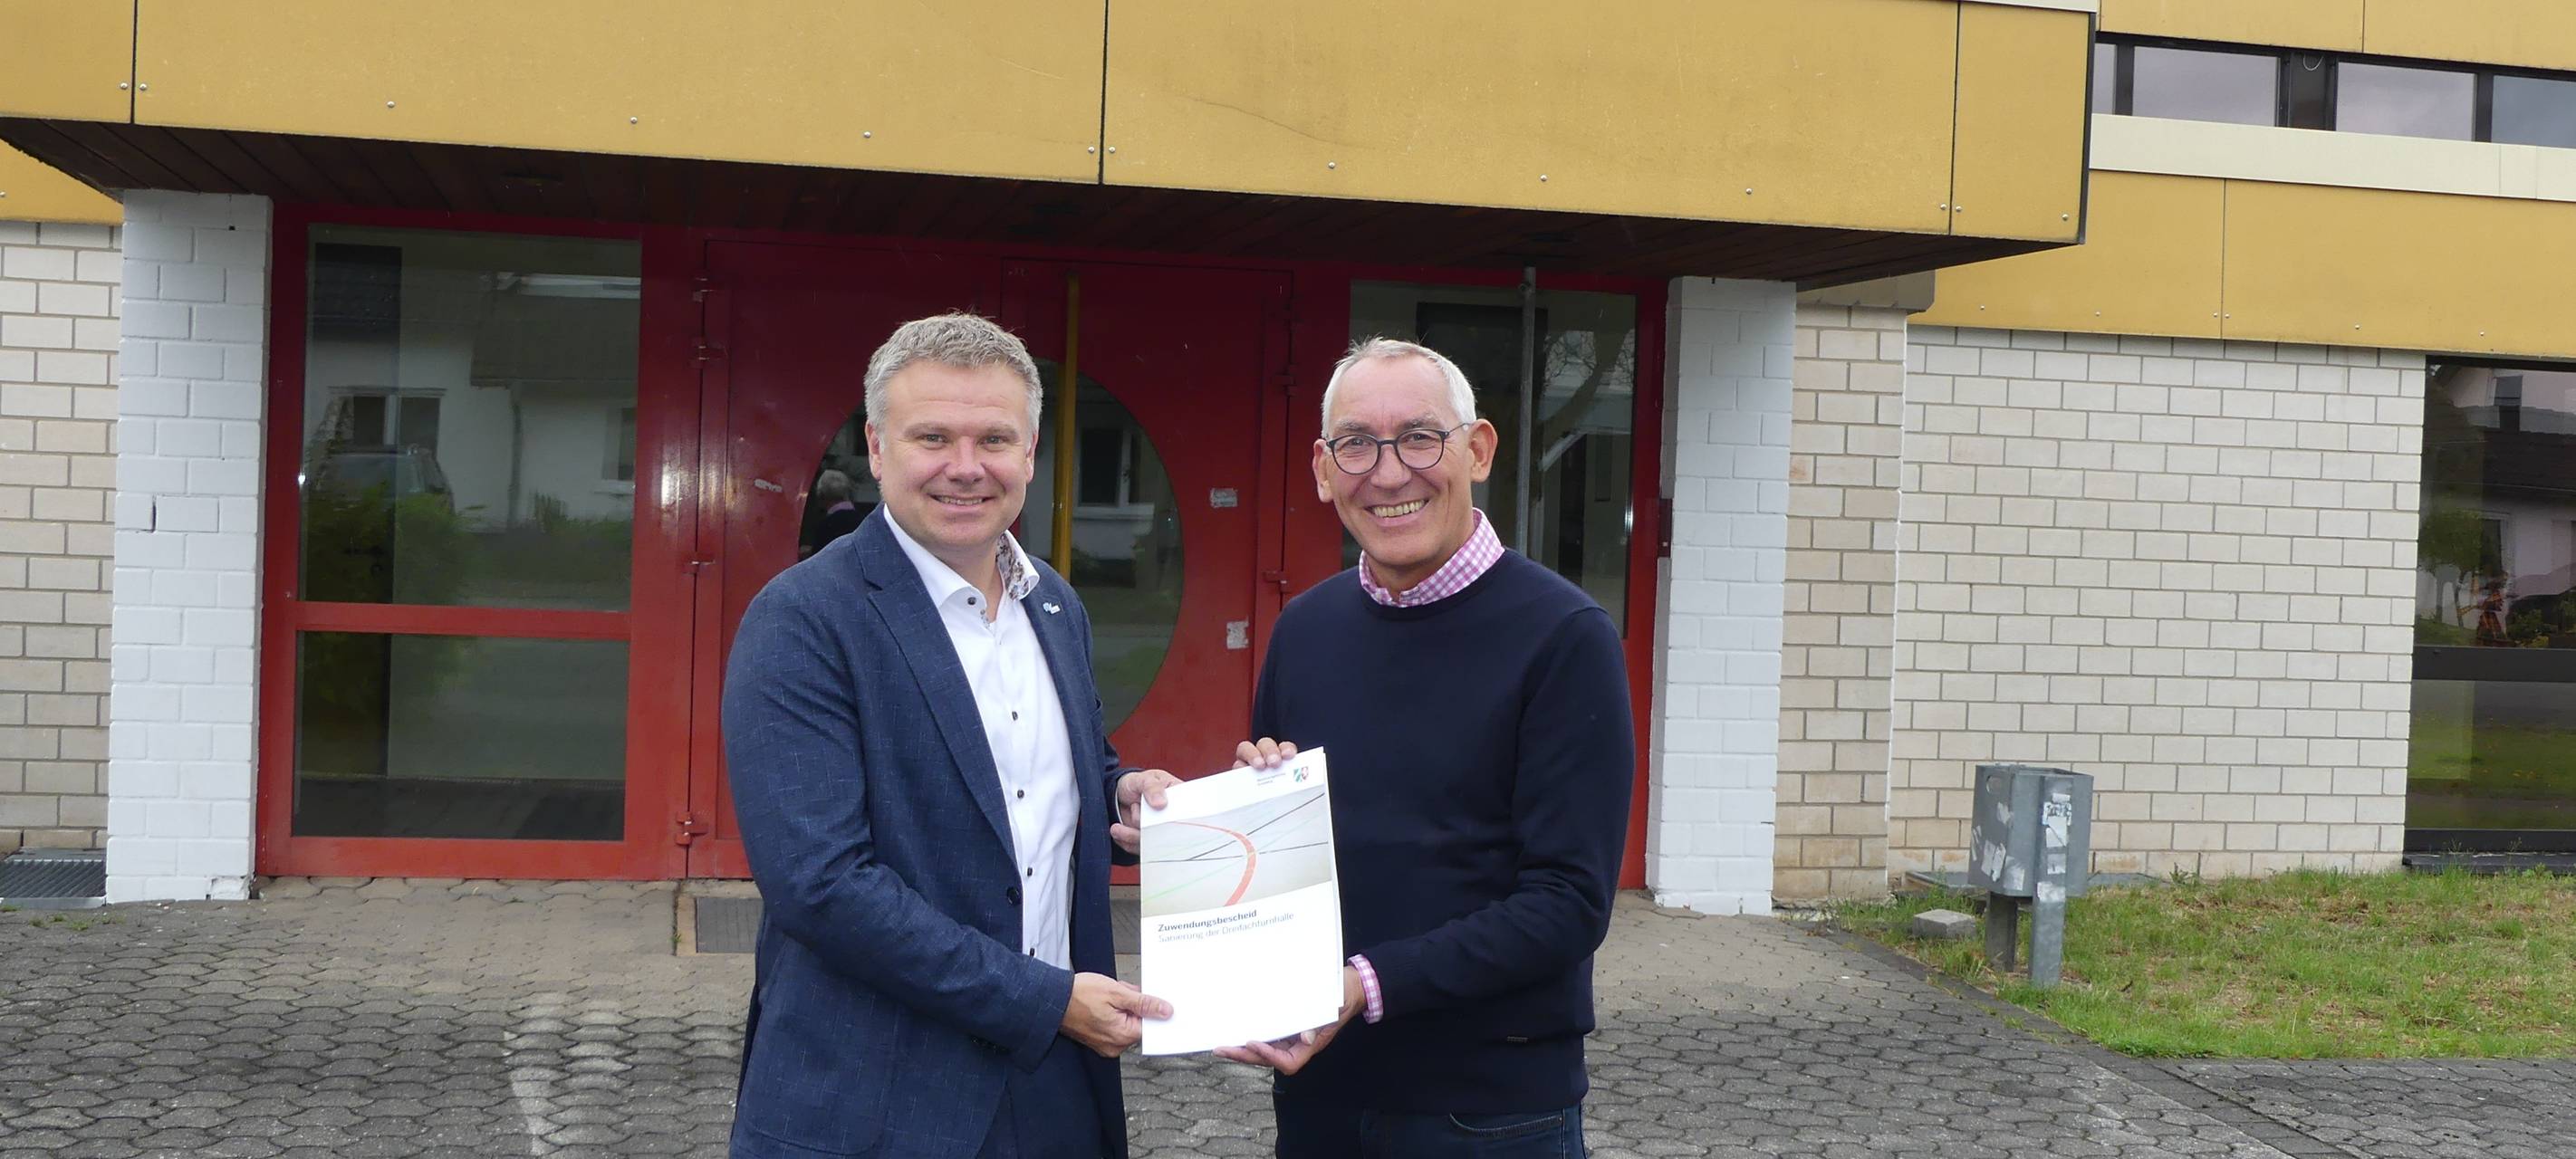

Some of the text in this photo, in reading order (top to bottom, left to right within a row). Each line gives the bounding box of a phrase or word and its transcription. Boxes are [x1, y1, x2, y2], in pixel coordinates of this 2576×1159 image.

[1158, 909, 1257, 932] Zuwendungsbescheid
[1158, 913, 1294, 943] Sanierung der Dreifachturnhalle
